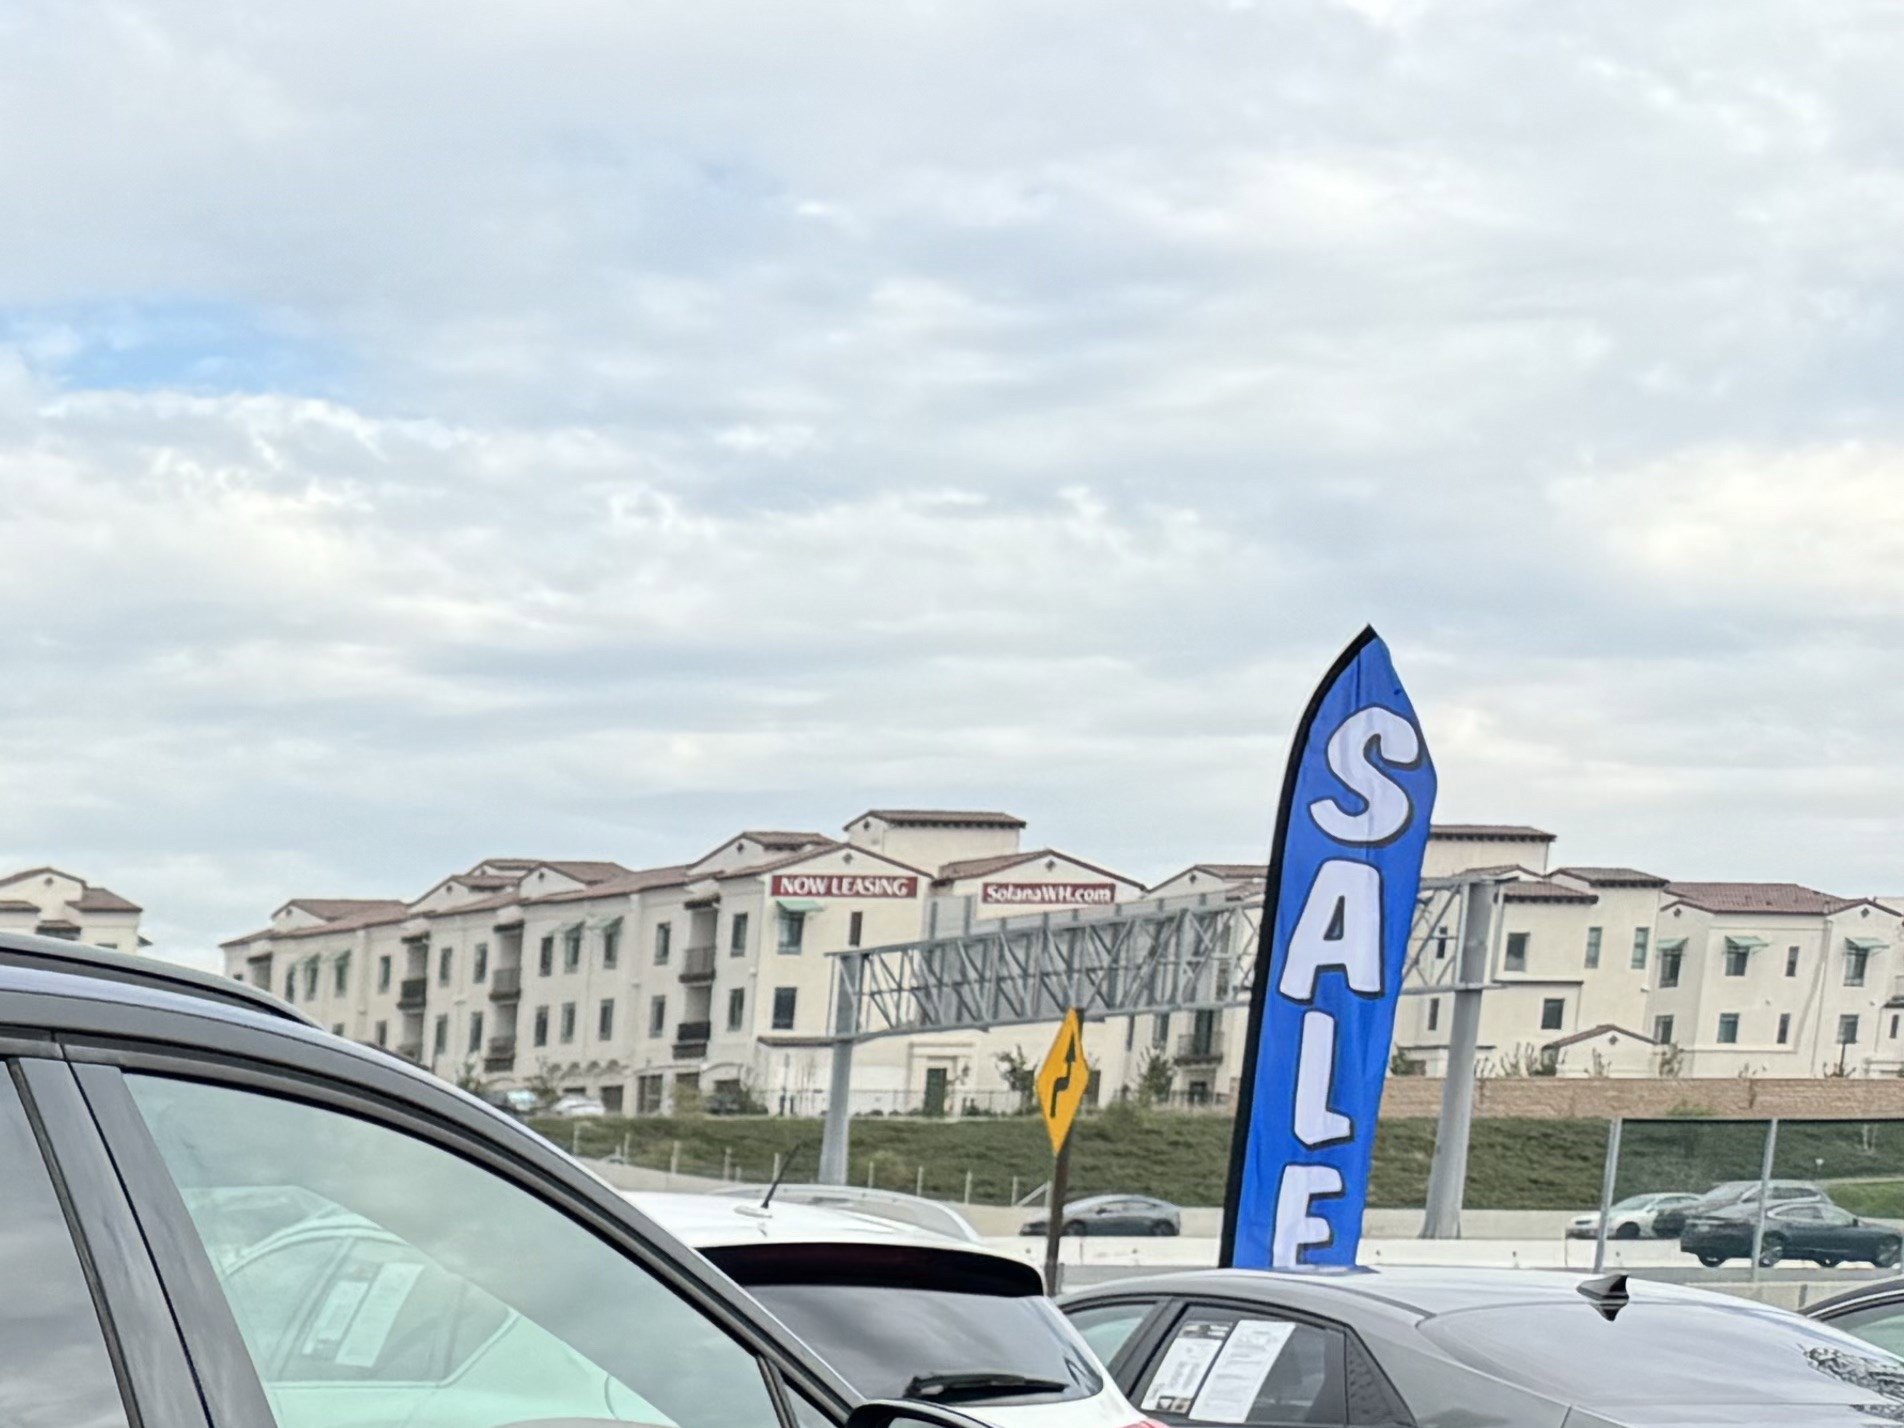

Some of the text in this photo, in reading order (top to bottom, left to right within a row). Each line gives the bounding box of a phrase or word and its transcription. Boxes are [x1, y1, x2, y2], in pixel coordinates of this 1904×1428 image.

[780, 876, 909, 896] NOW LEASING
[1272, 705, 1420, 1268] SALE
